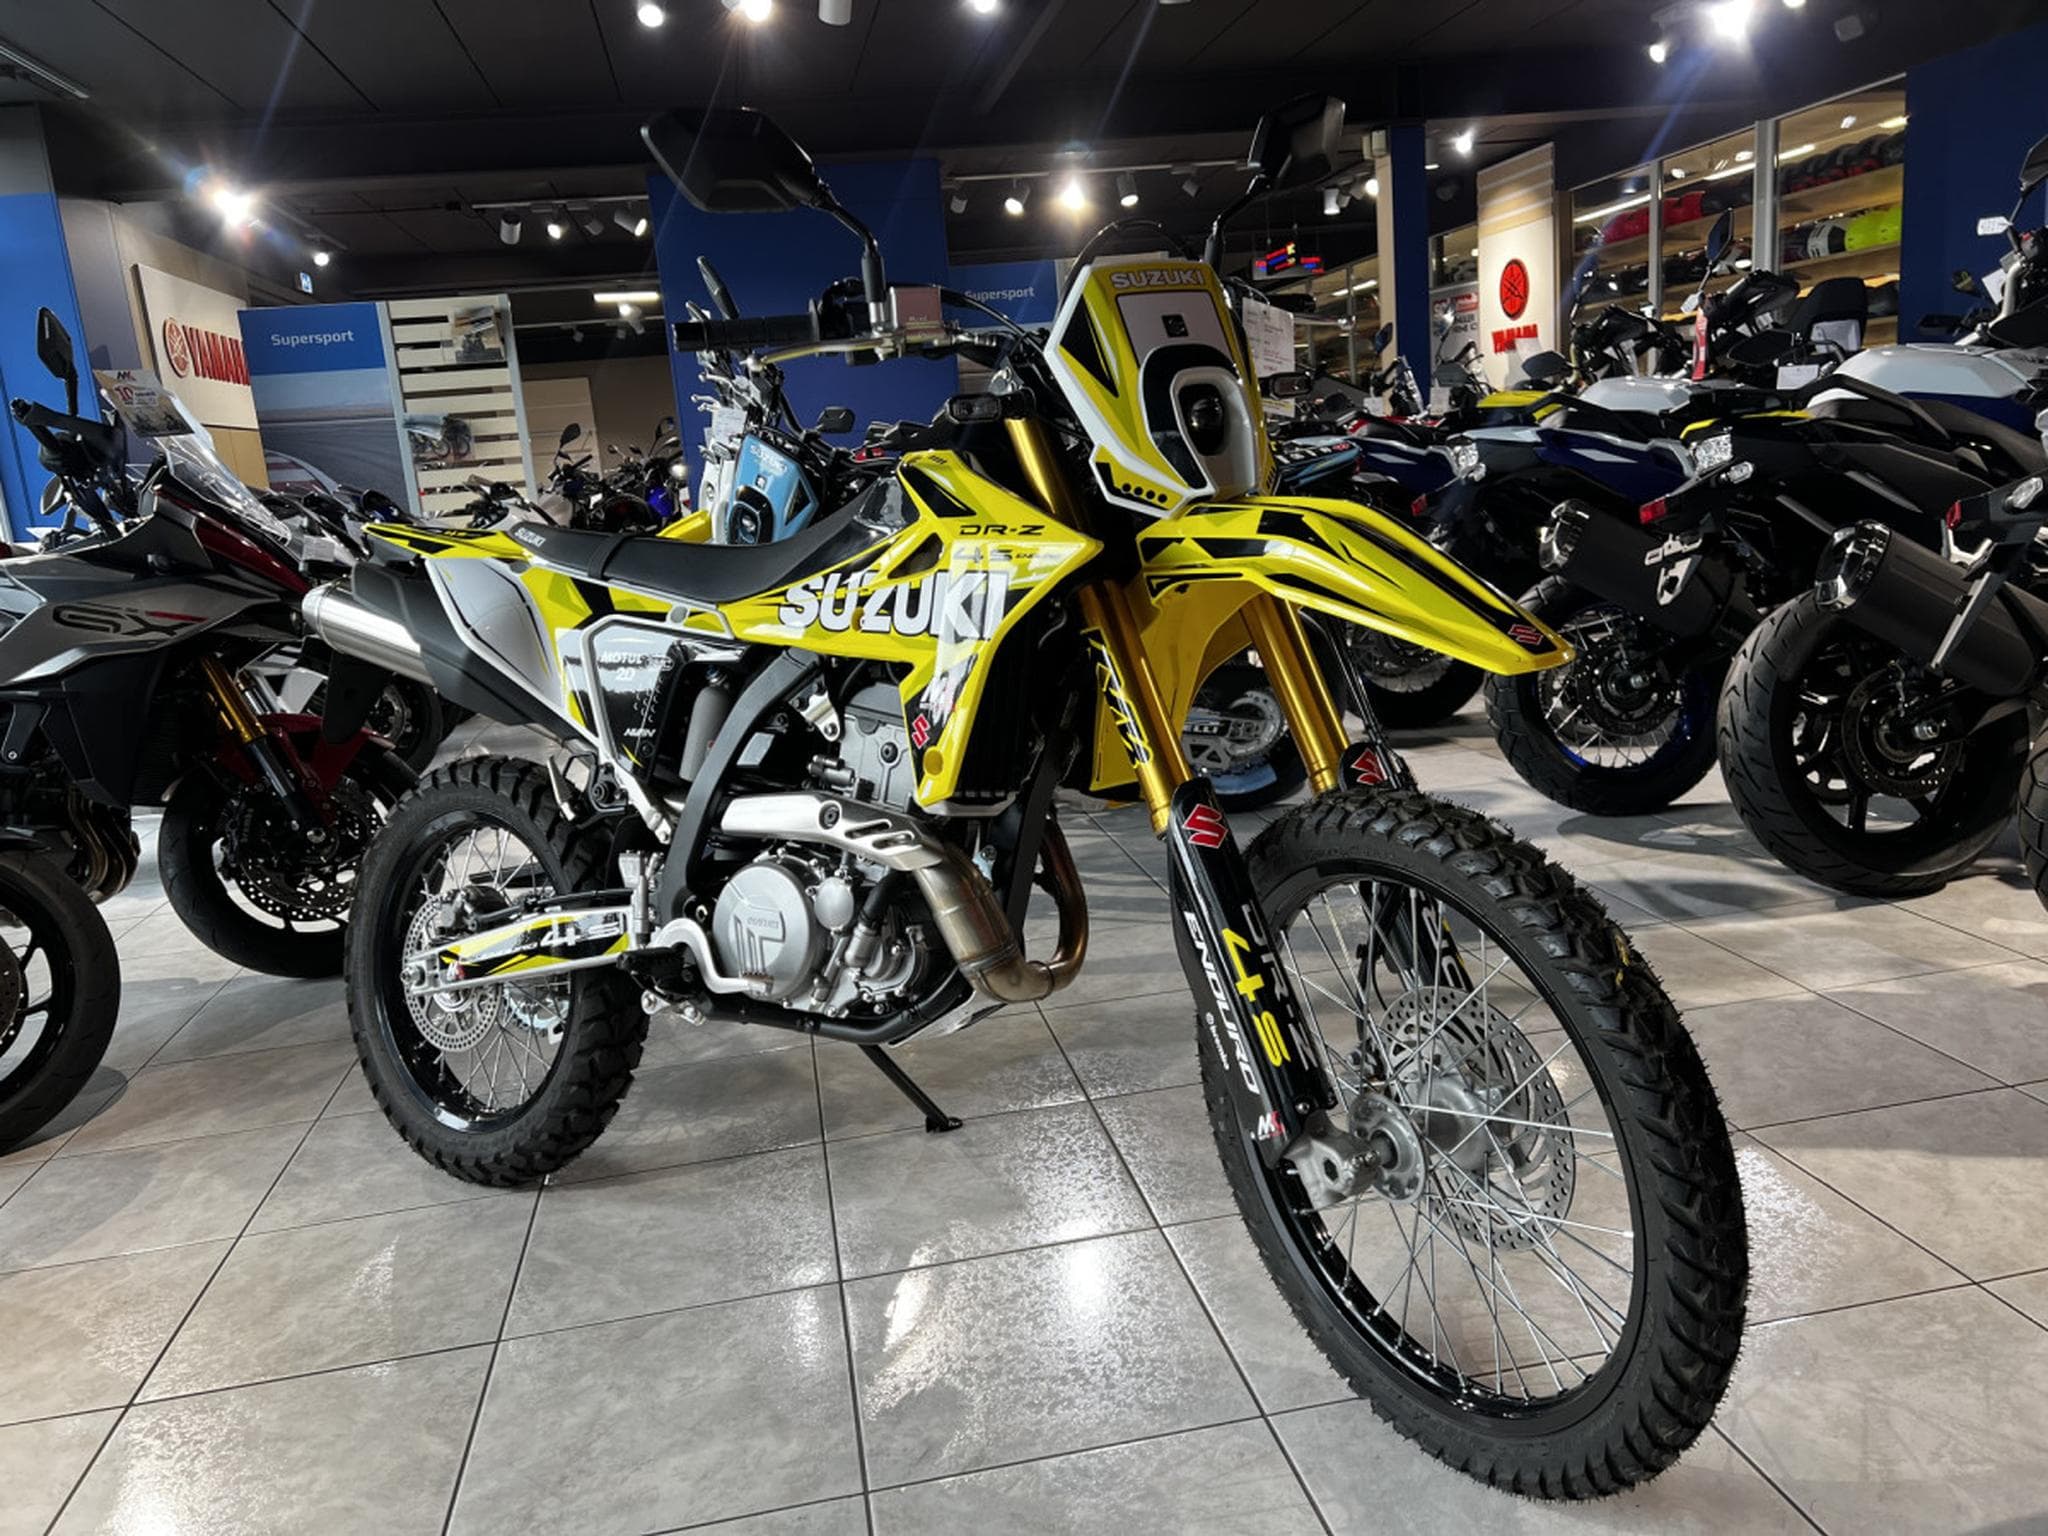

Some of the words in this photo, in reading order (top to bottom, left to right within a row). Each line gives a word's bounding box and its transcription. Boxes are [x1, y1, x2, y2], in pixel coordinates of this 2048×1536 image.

[1110, 270, 1205, 288] SUZUKI
[964, 286, 1035, 301] Supersport
[271, 330, 354, 347] Supersport
[513, 527, 546, 548] SUZUKI
[959, 524, 1046, 536] DR-Z
[778, 569, 1008, 641] SUZUKI
[1184, 911, 1260, 1095] ENDURO
